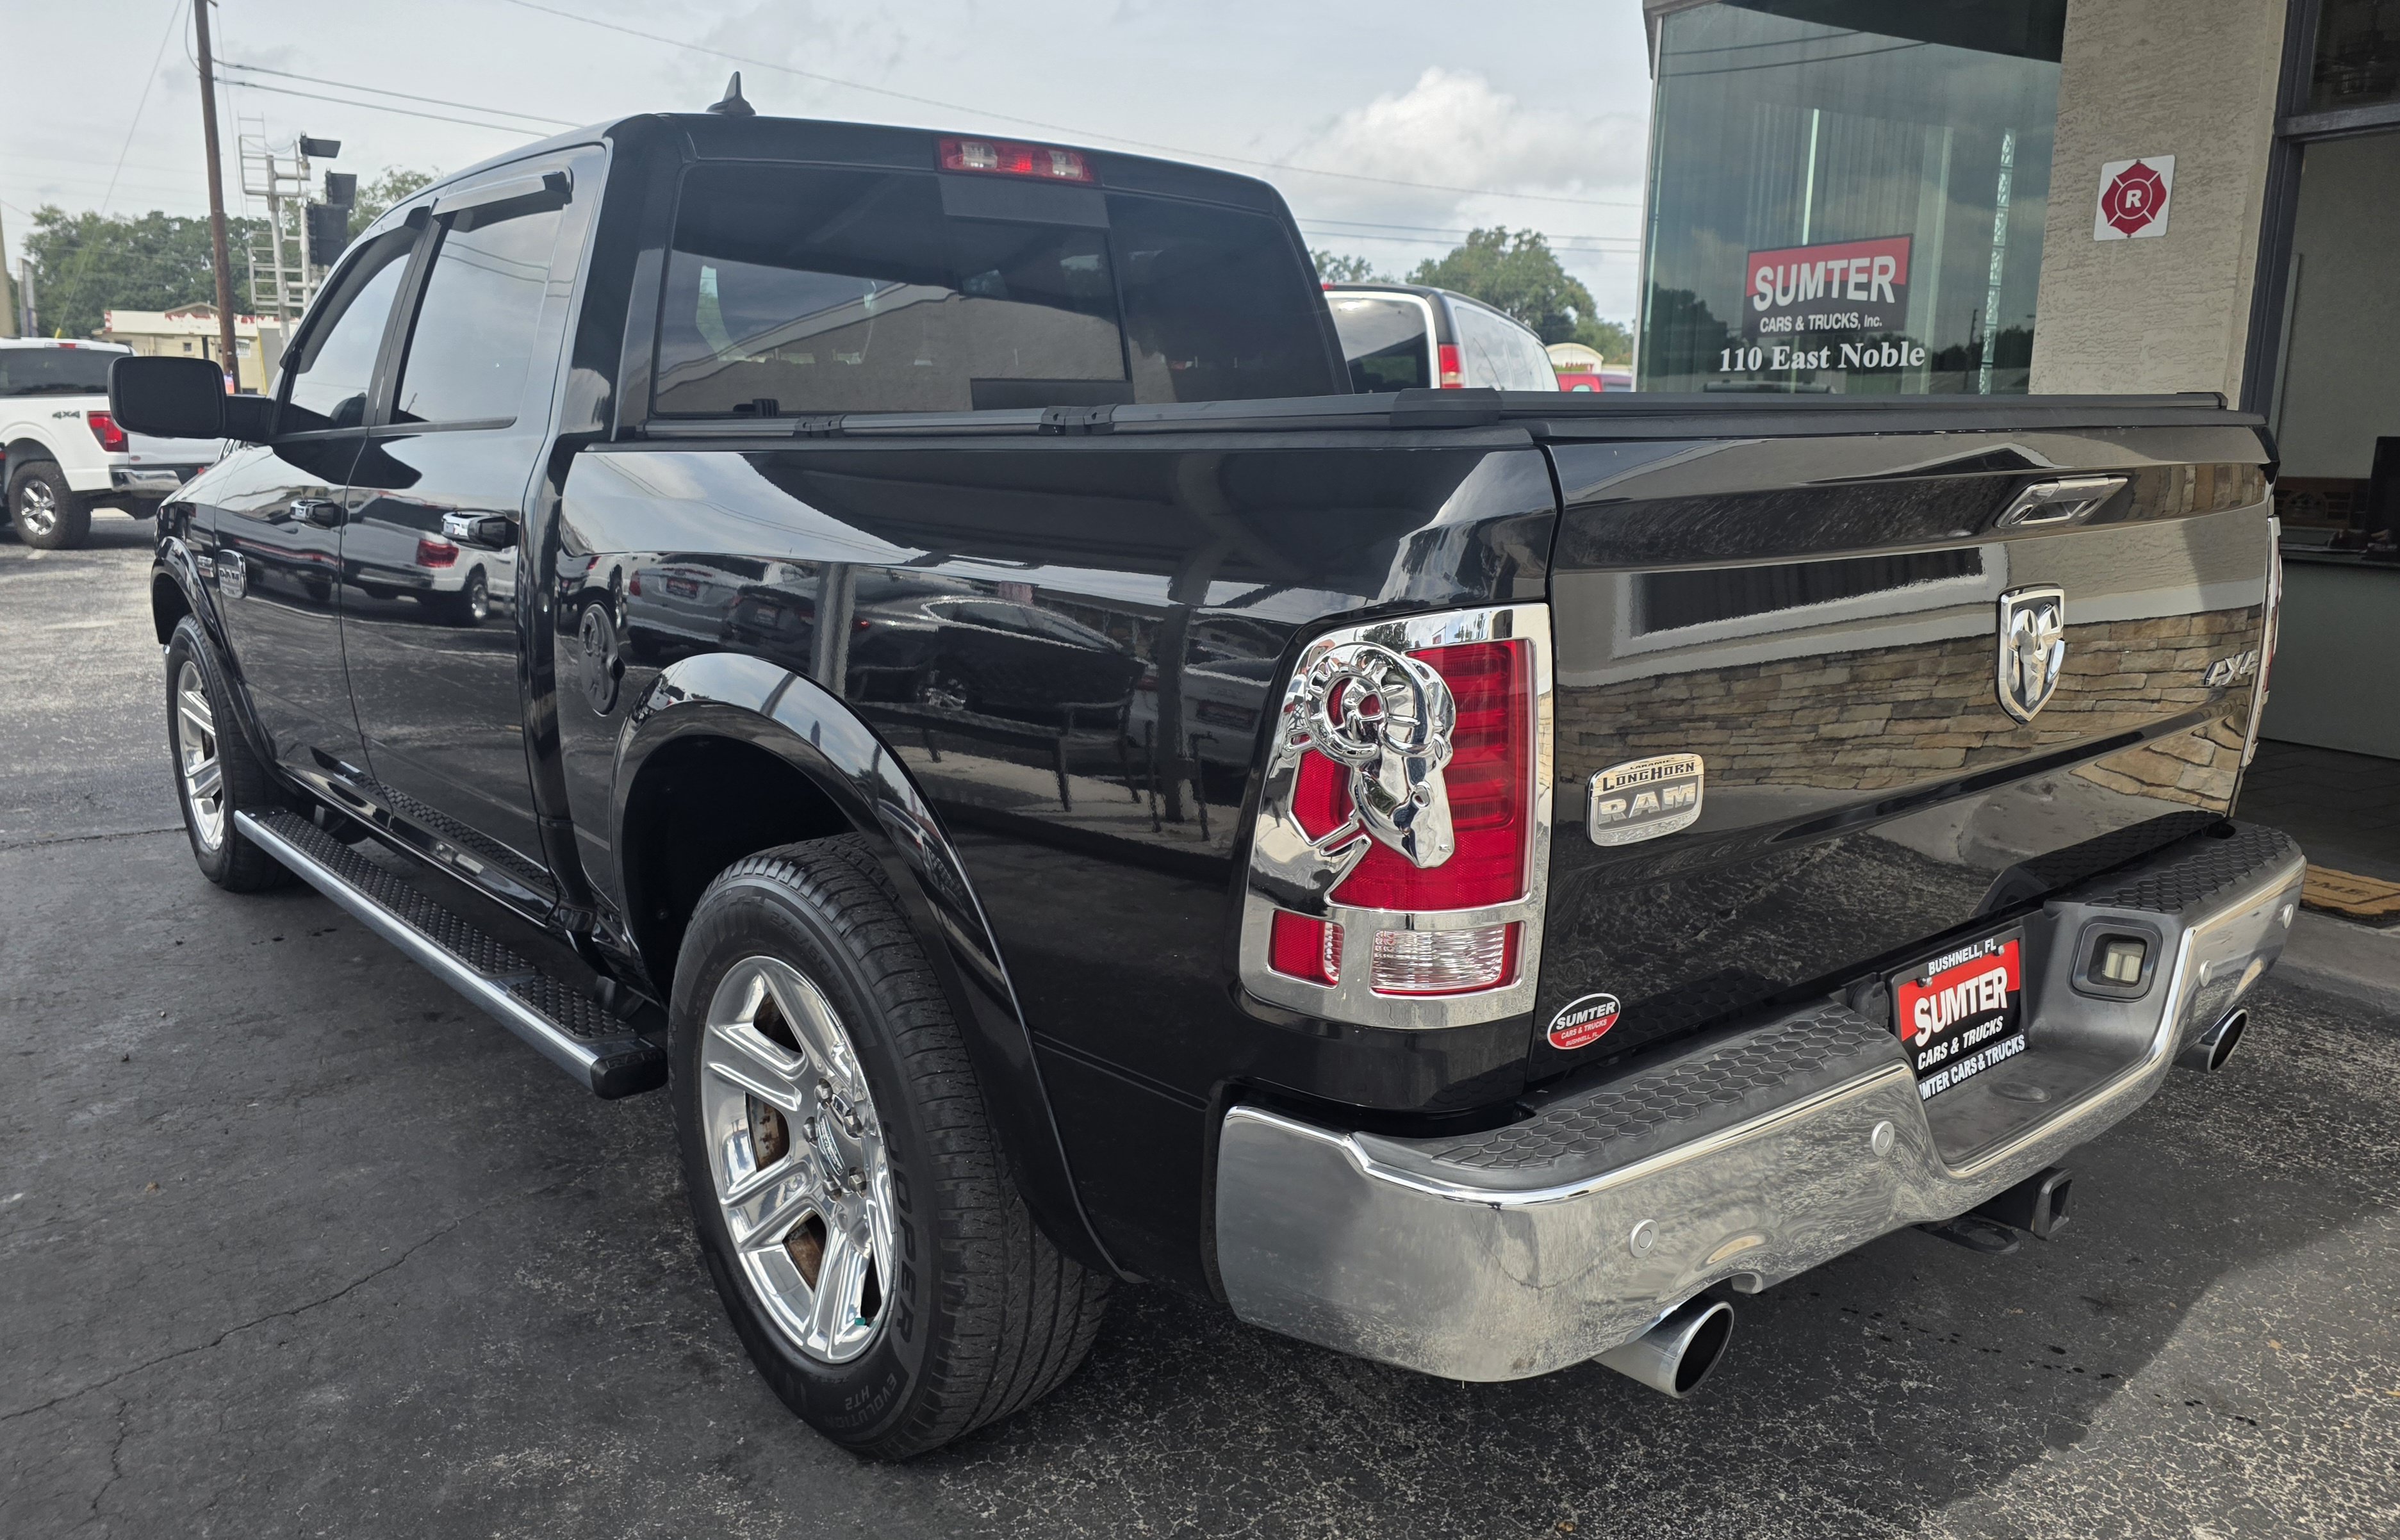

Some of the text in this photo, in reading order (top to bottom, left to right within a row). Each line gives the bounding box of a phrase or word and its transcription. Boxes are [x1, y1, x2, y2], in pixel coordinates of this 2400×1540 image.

[2125, 190, 2142, 208] R
[1753, 256, 1896, 311] SUMTER
[1760, 312, 1882, 332] CARS & TRUCKS, Inc.
[1720, 341, 1925, 372] 110 East Noble
[1598, 782, 1696, 825] RAM
[1928, 938, 1996, 976] BUSHNELL, FL
[1556, 1001, 1616, 1030] SUMTER
[1914, 967, 2007, 1047] SUMTER
[1561, 1028, 1577, 1039] CARS
[1584, 1019, 1607, 1032] TRUCKS
[1918, 1015, 2003, 1070] CARS & TRUCKS
[1985, 1034, 2025, 1067] TRUCKS
